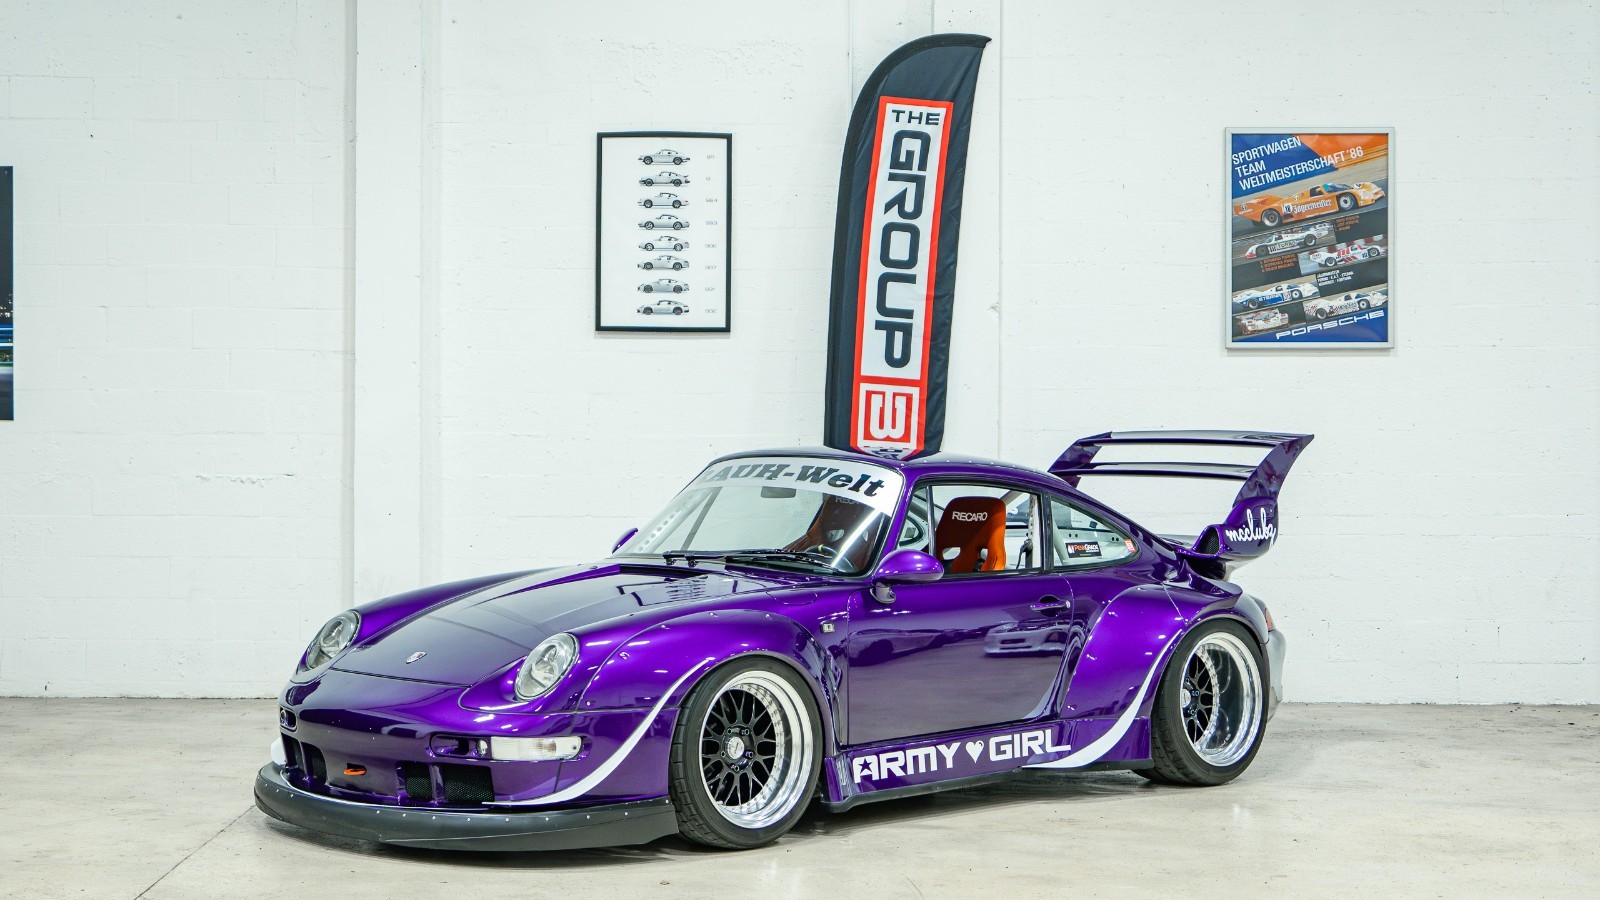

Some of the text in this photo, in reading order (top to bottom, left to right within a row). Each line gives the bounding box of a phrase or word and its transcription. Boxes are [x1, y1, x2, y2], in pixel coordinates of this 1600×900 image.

[892, 109, 941, 126] THE
[1232, 135, 1302, 165] SPORTWAGEN
[1235, 160, 1266, 178] TEAM
[1239, 146, 1364, 191] WELTMEISTERSCHAFT '86
[874, 129, 931, 369] GROUP
[1276, 309, 1385, 340] PORSCHE
[951, 510, 988, 522] RECARO
[852, 728, 1072, 784] ARMY GIRL
